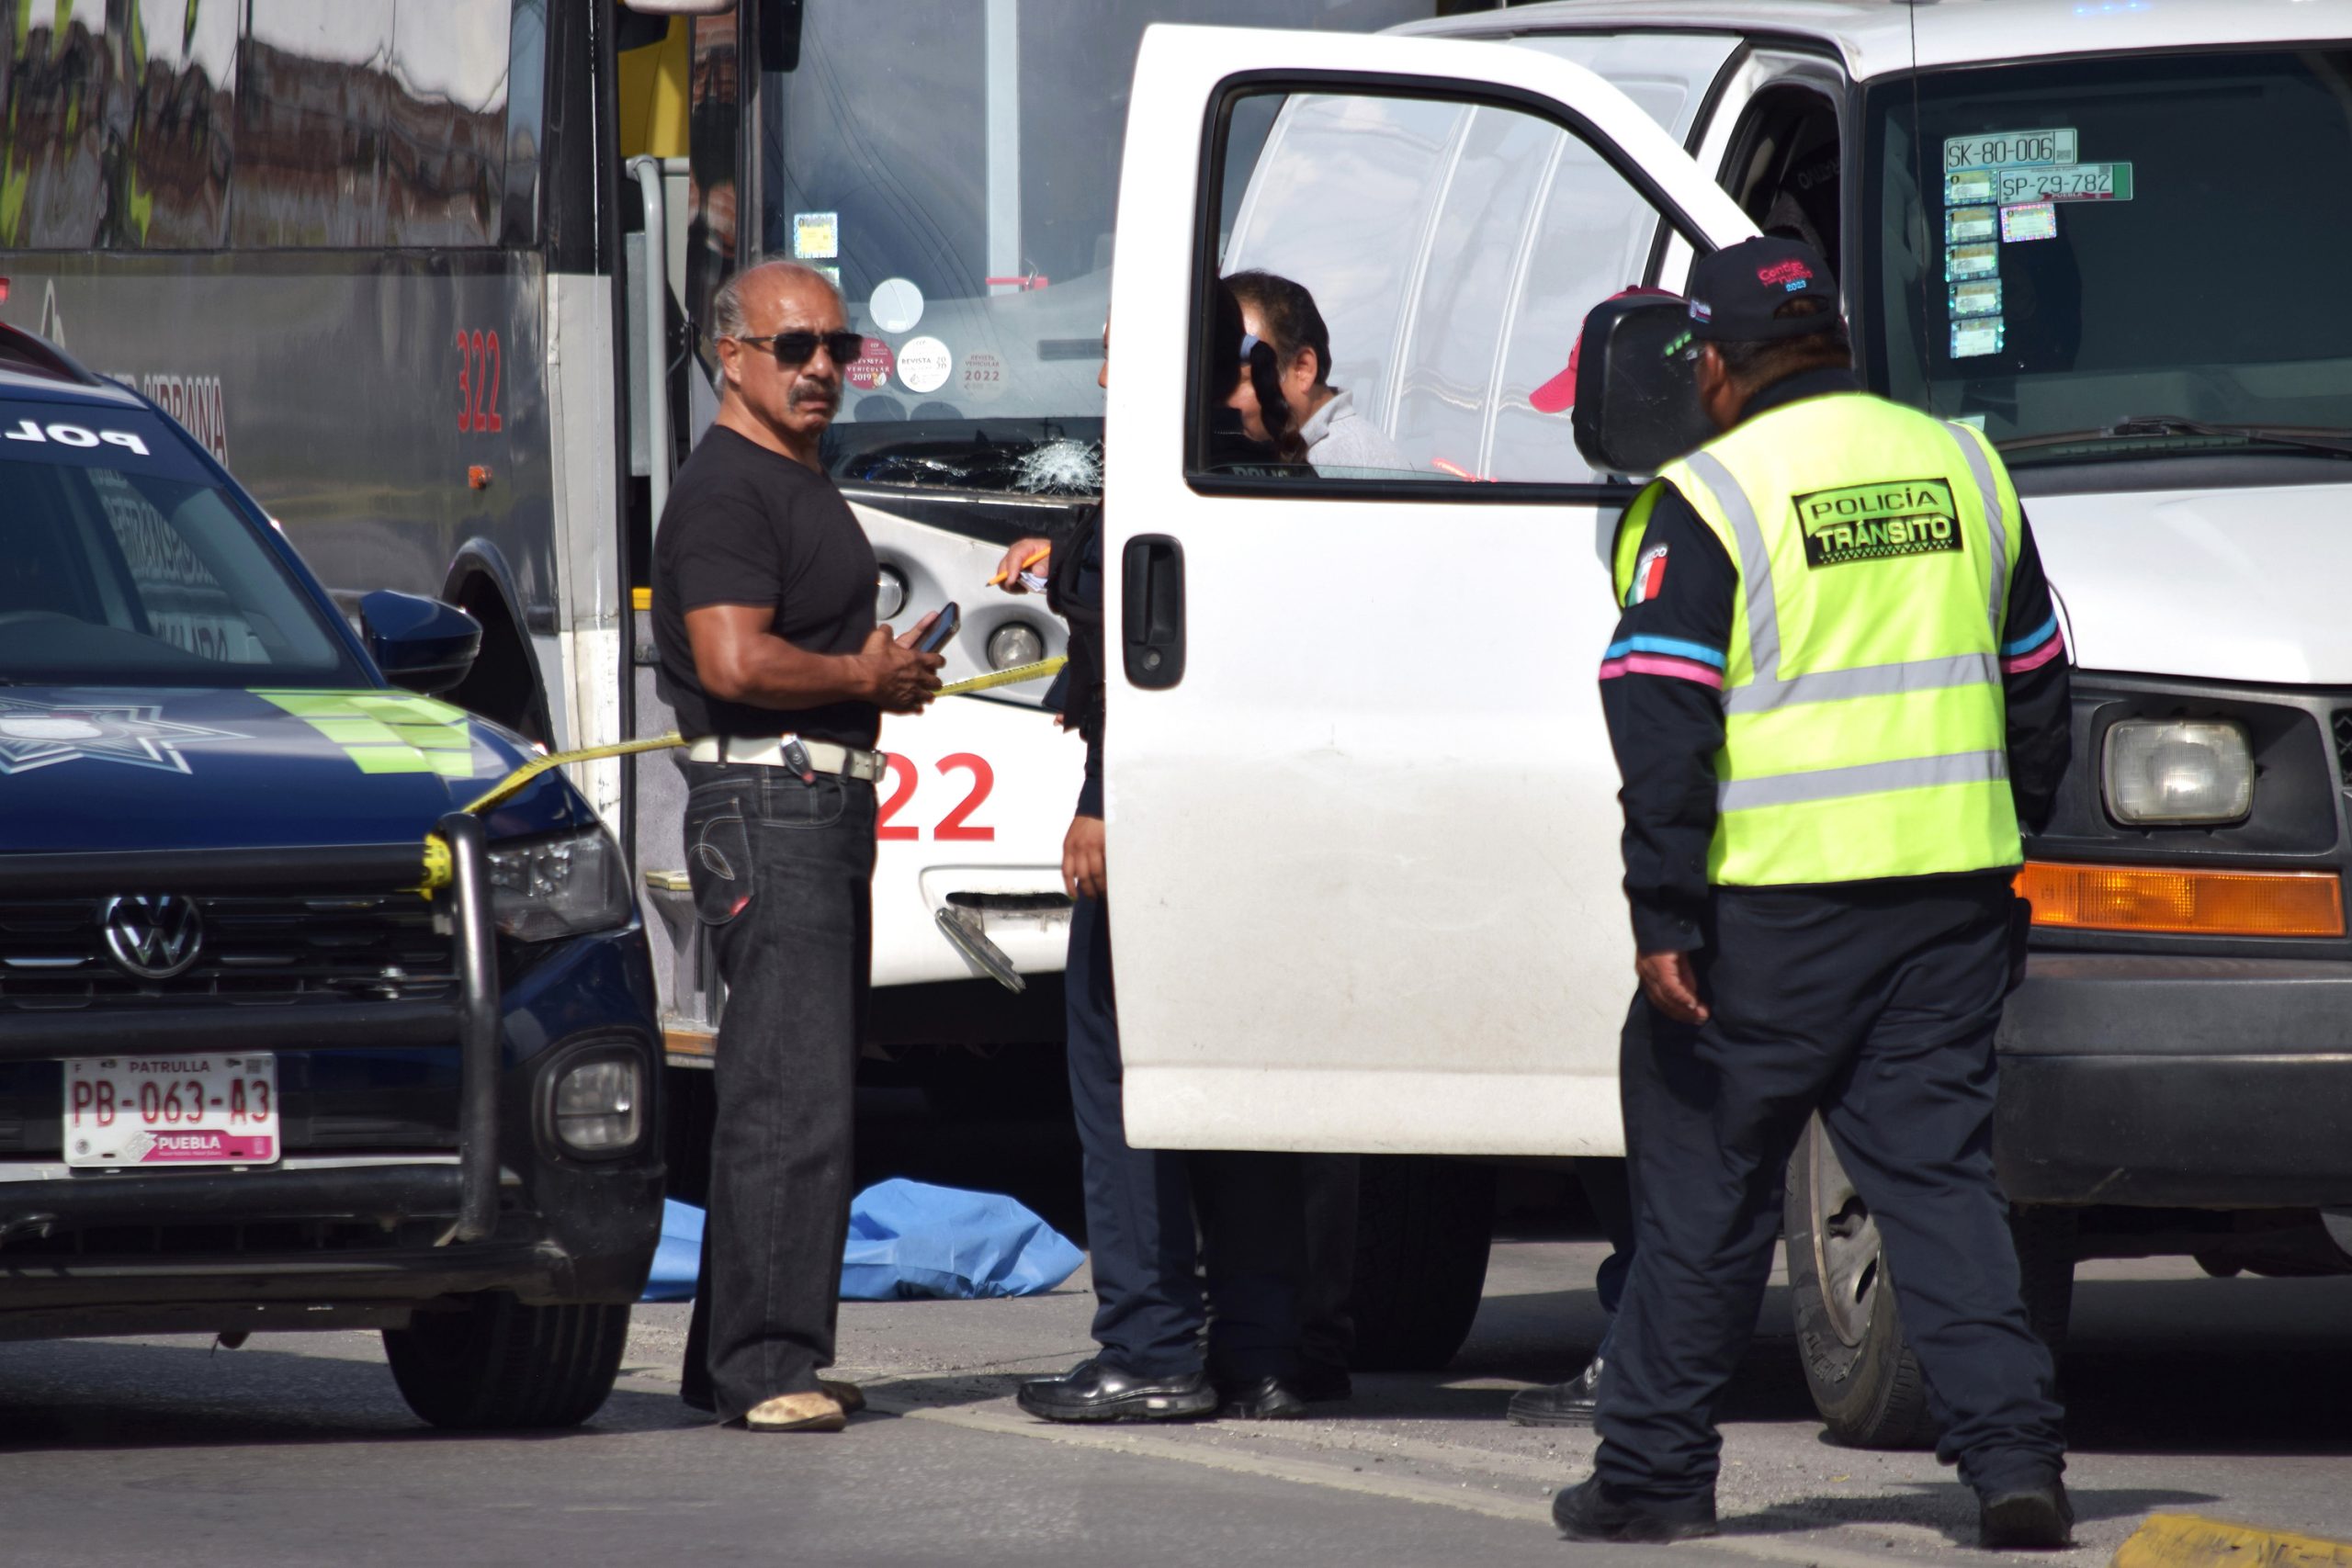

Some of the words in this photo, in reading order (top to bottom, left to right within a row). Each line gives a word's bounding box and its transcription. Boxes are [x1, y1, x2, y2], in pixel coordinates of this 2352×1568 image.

[1948, 137, 2053, 168] SK-80-006
[2002, 174, 2110, 197] SP-29-782
[456, 328, 503, 433] 322
[852, 373, 872, 381] 2019
[965, 370, 1001, 381] 2022
[1810, 487, 1939, 521] POLICÍA
[1815, 516, 1951, 553] TRÁNSITO
[129, 1061, 210, 1073] PATRULLA
[73, 1078, 271, 1128] PB-063-A3
[158, 1135, 221, 1150] PUEBLA
